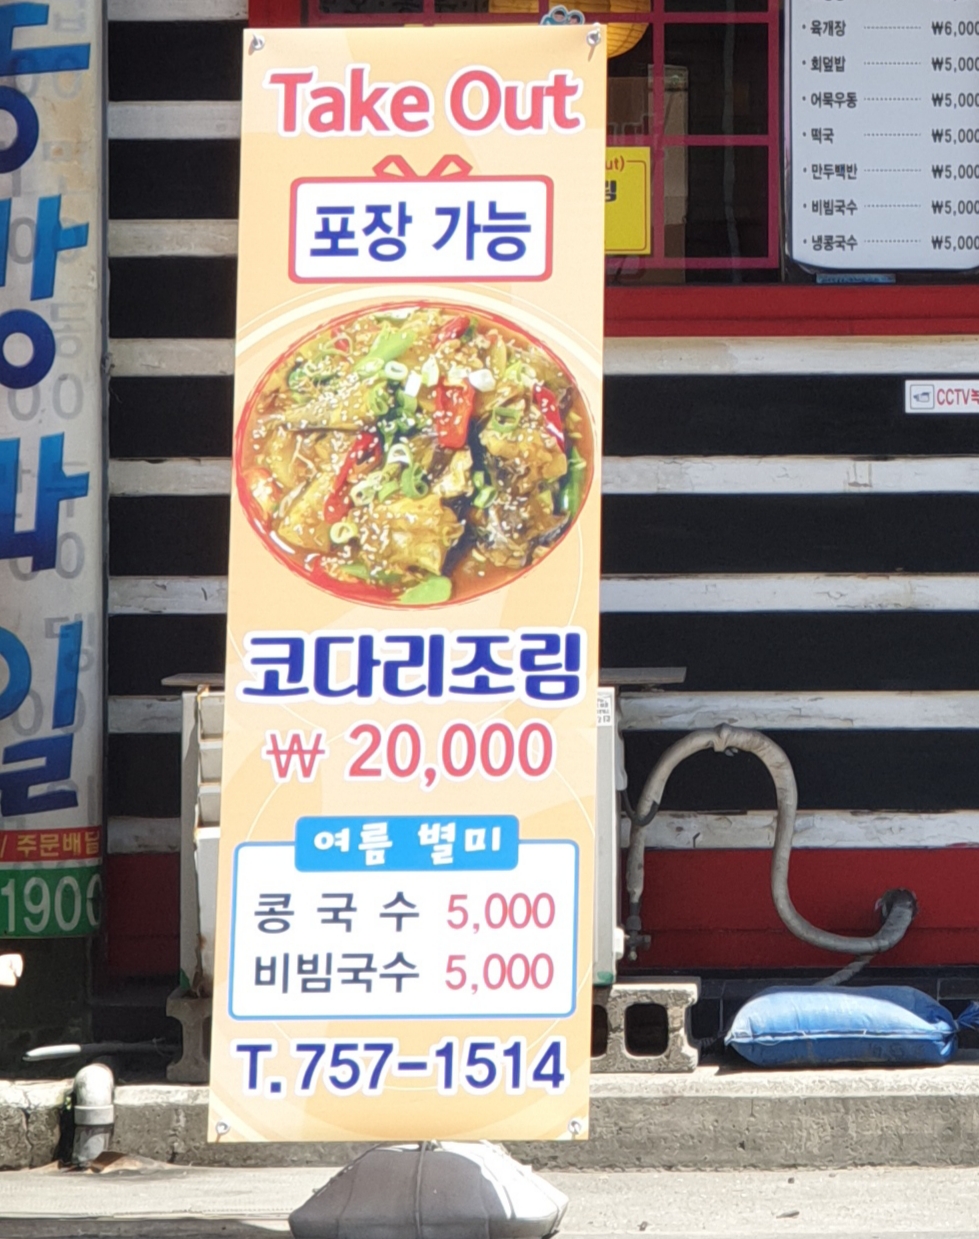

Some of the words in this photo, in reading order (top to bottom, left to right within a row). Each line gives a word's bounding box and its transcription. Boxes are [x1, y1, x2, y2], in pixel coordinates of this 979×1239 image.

[809, 19, 847, 37] 육개장
[810, 55, 846, 73] 회덮밥
[267, 66, 432, 135] Take
[447, 67, 583, 132] Out
[810, 91, 858, 109] 어묵우동
[810, 127, 835, 145] 떡국
[811, 163, 858, 180] 만두백반
[811, 199, 858, 216] 비빔국수
[309, 201, 413, 262] 포장
[432, 200, 532, 262] 가능
[811, 234, 858, 252] 냉콩국수
[241, 632, 582, 702] 코다리조림
[313, 822, 393, 866] 여름
[418, 822, 501, 865] 별미
[446, 892, 556, 934] 5,000
[254, 952, 420, 994] 비빔국수
[445, 953, 555, 995] 5,000
